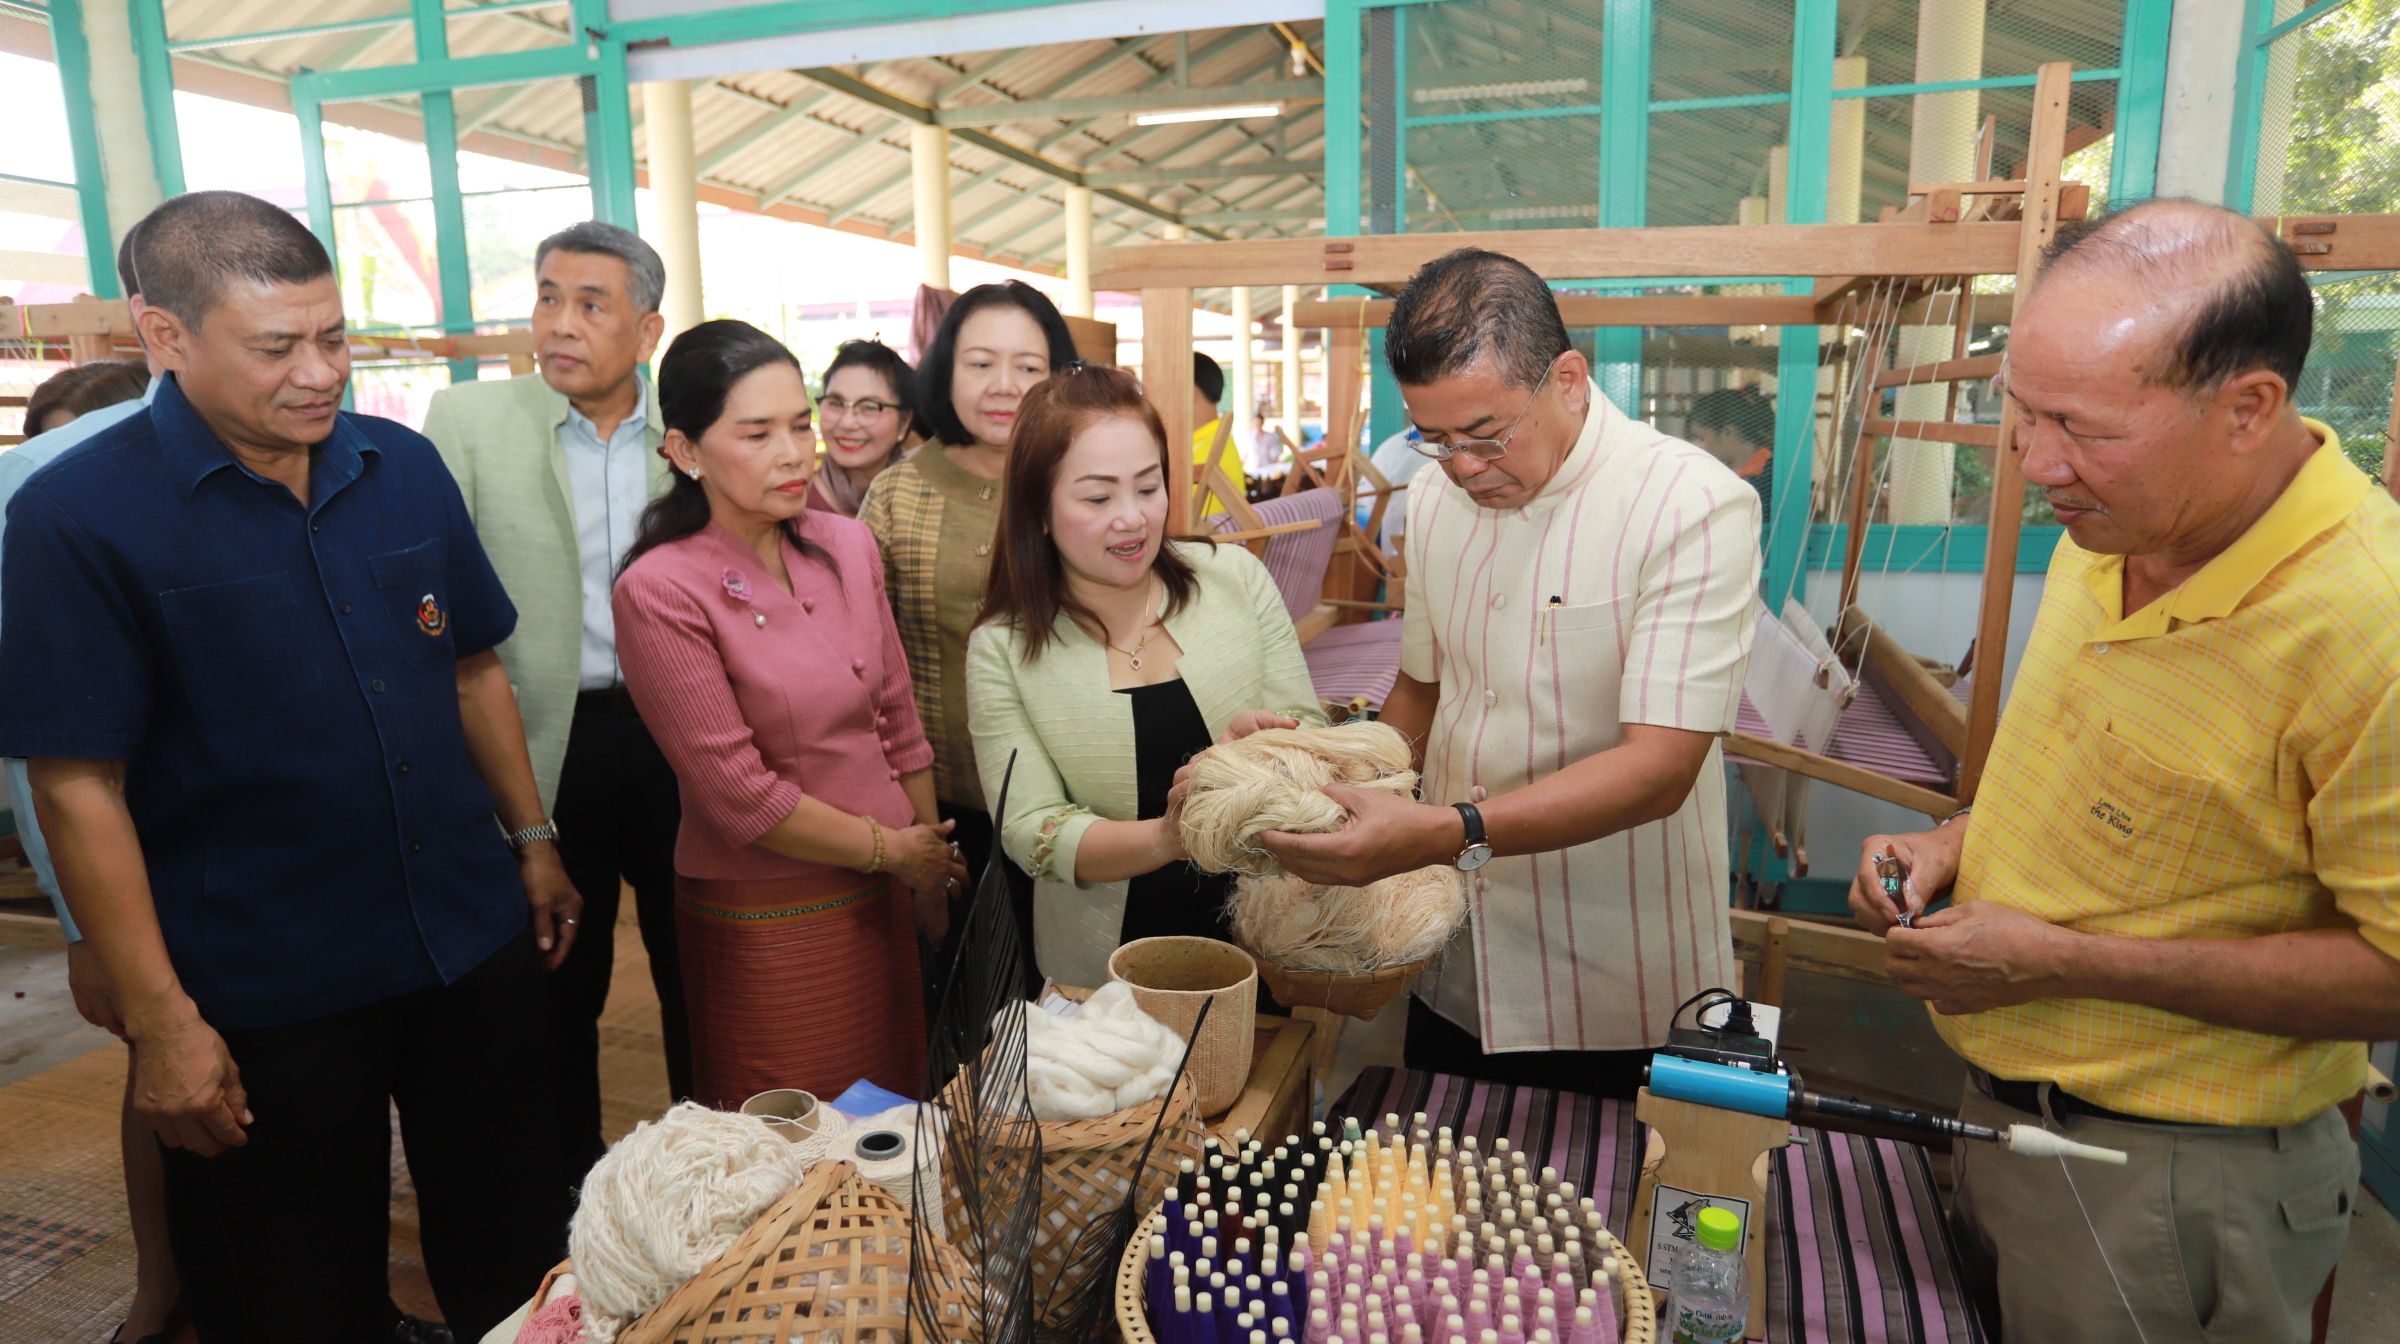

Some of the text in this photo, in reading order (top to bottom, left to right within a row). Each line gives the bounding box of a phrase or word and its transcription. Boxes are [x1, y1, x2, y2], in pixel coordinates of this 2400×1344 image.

[2097, 797, 2115, 812] Long
[2090, 805, 2134, 839] the King
